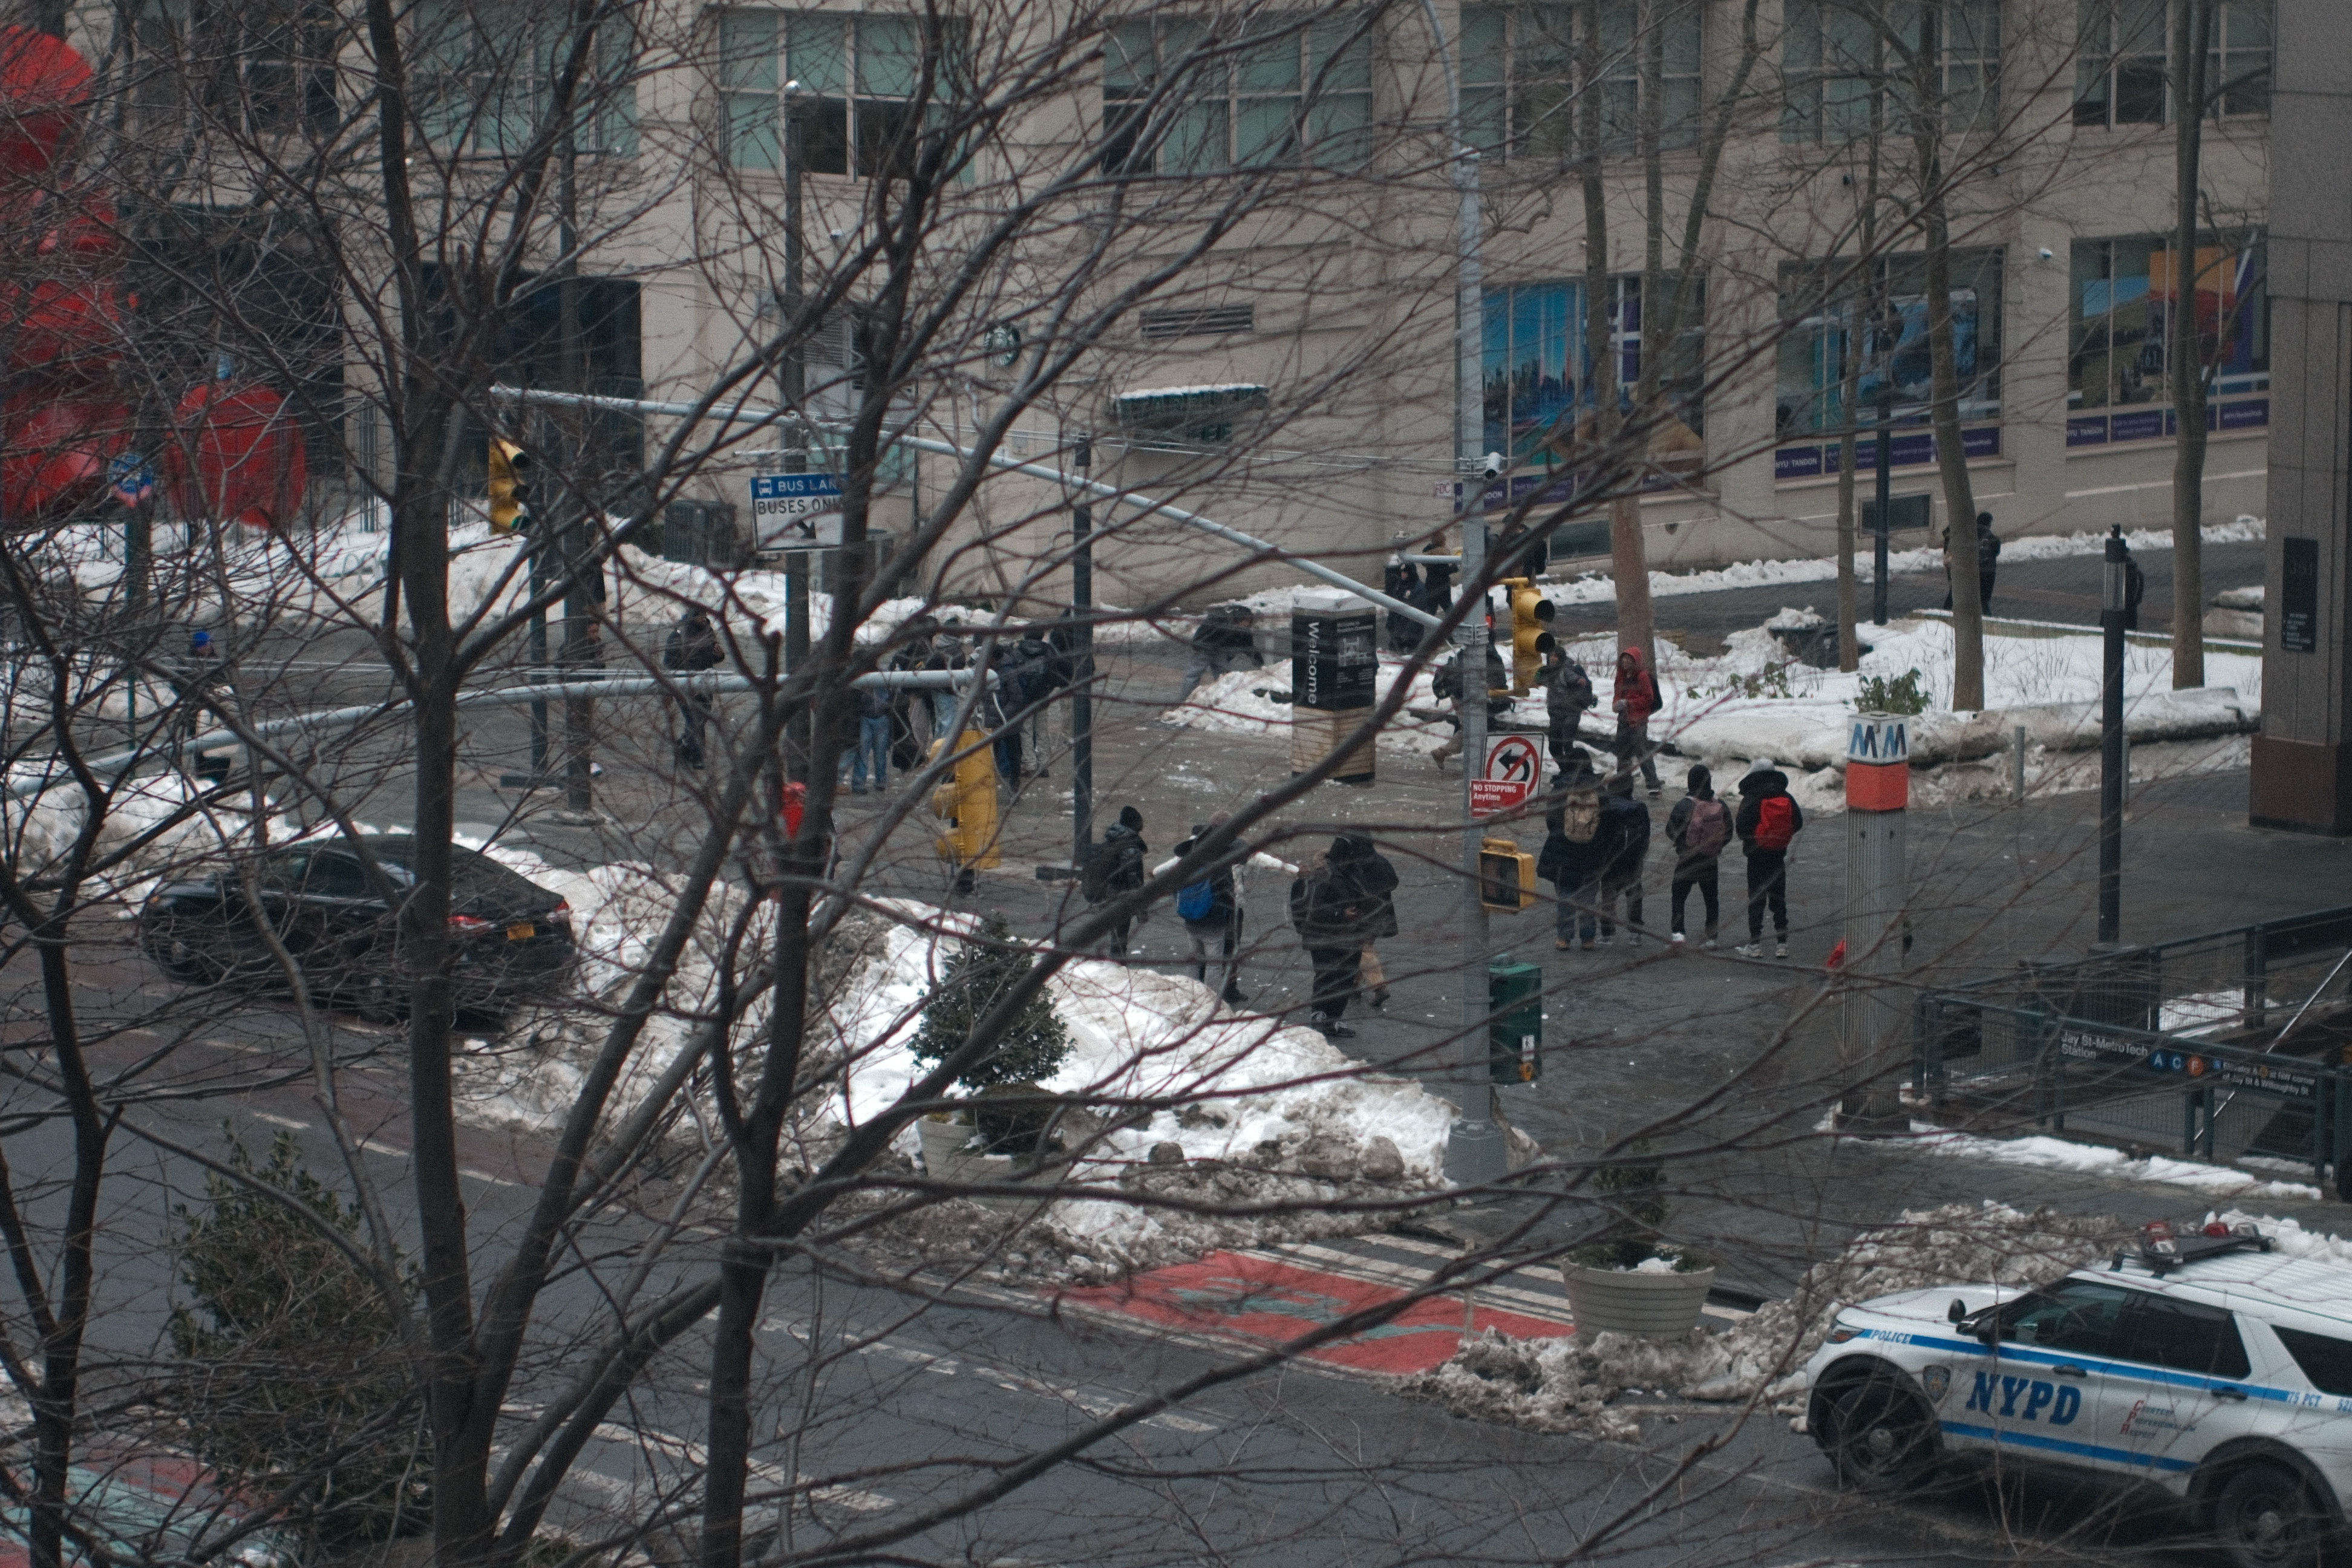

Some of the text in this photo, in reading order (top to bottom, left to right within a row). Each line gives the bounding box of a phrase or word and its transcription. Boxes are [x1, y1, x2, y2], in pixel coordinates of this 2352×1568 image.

[1776, 457, 1817, 469] NYU TANDON
[778, 480, 804, 492] BUS
[758, 499, 805, 515] BUSES
[1308, 621, 1319, 704] Welcome
[1485, 785, 1516, 793] STOPPING
[1474, 793, 1500, 802] Anytime
[2060, 1031, 2079, 1047] Jay
[2062, 1044, 2097, 1060] Station
[2154, 1053, 2163, 1067] A
[2172, 1057, 2181, 1070] C
[2191, 1060, 2199, 1071] F
[1870, 1329, 1911, 1344] POLICE
[1965, 1371, 2082, 1426] NYPD
[2302, 1393, 2322, 1407] PCT
